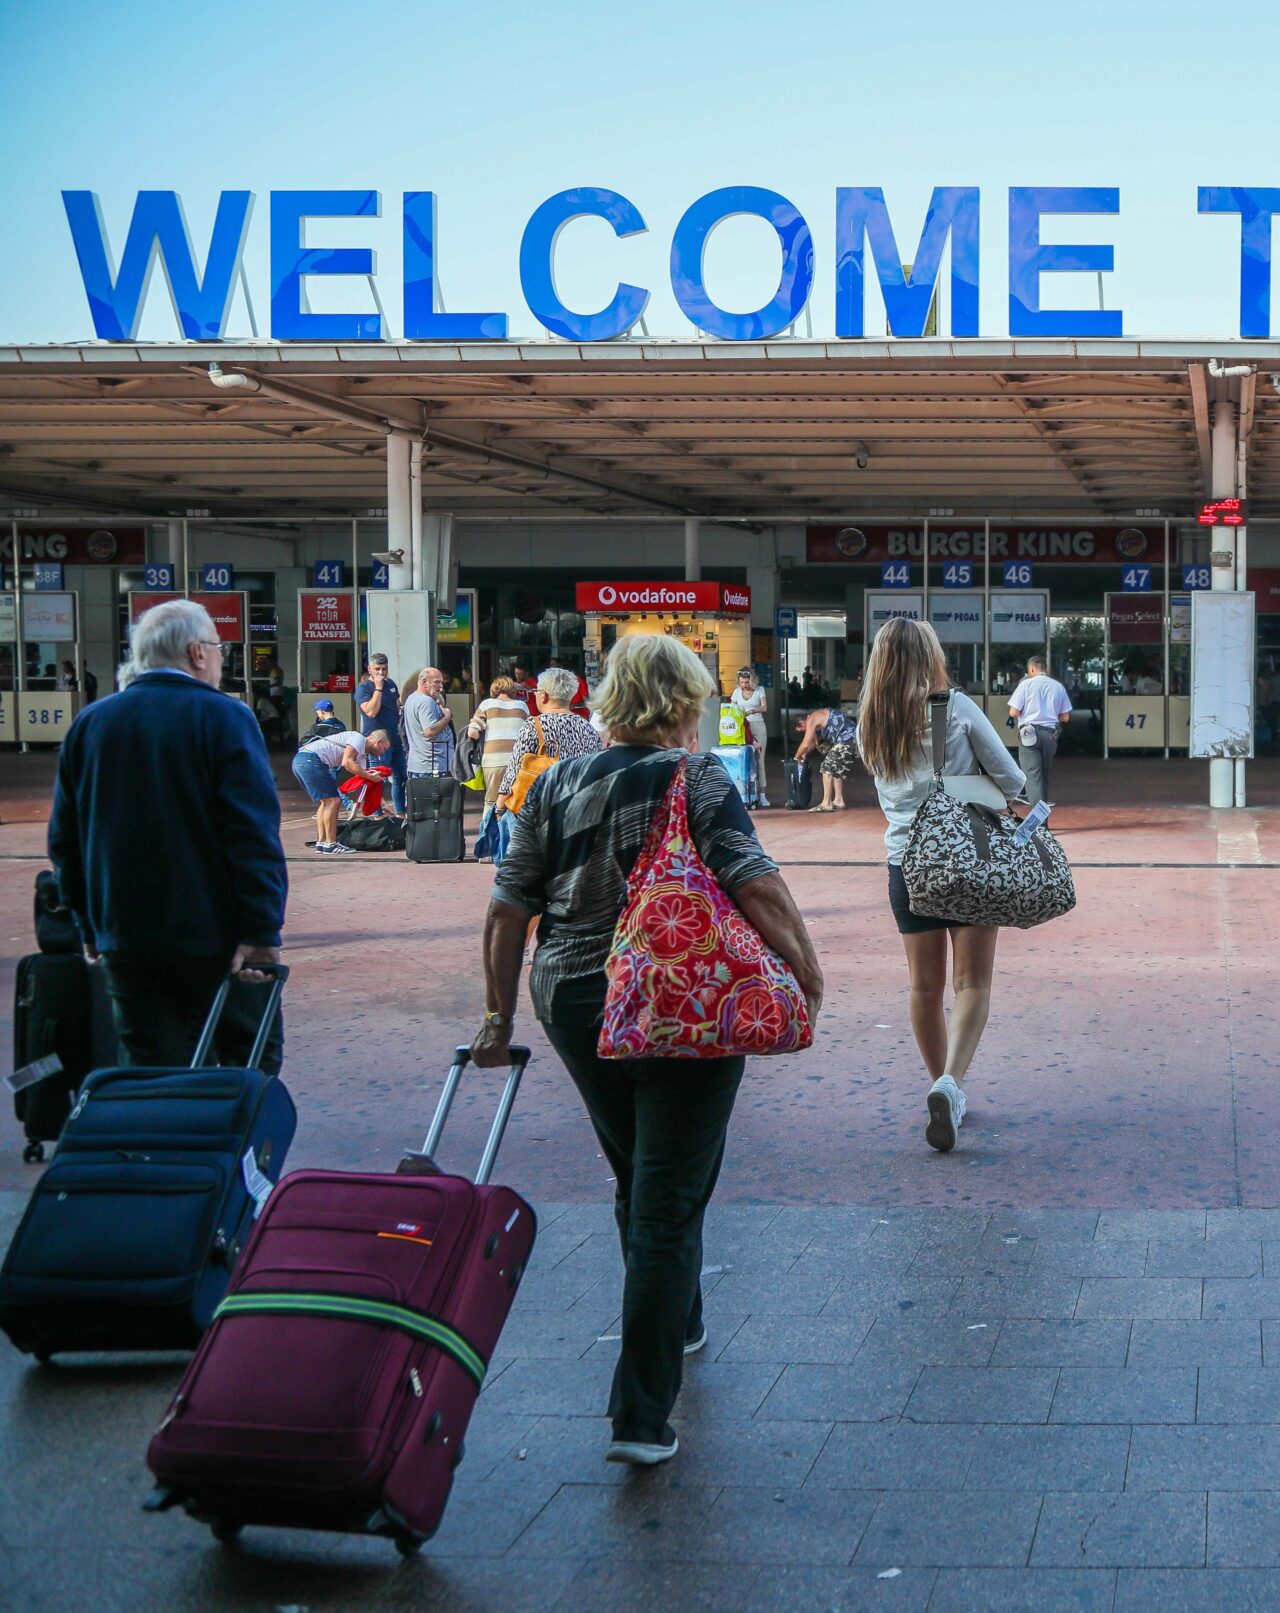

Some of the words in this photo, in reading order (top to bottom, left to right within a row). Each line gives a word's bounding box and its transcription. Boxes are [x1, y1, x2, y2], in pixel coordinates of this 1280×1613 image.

[62, 185, 1123, 342] WELCOME
[887, 531, 1008, 556] BURGER
[1018, 531, 1094, 556] KING
[36, 572, 60, 583] 38F
[146, 568, 170, 586] 39
[206, 568, 229, 586] 40
[318, 566, 340, 583] 41
[884, 566, 908, 584] 44
[945, 566, 970, 584] 45
[1005, 566, 1030, 584] 46
[1124, 569, 1149, 587] 47
[1185, 569, 1210, 587] 48
[619, 588, 696, 604] vodafone
[730, 592, 748, 606] vodafone
[317, 610, 338, 620] TOUR
[892, 610, 918, 619] PEGAS
[954, 613, 980, 622] PEGAS
[1015, 614, 1040, 622] PEGAS
[1135, 611, 1160, 620] Select
[28, 710, 64, 724] 38F
[1125, 714, 1147, 728] 47
